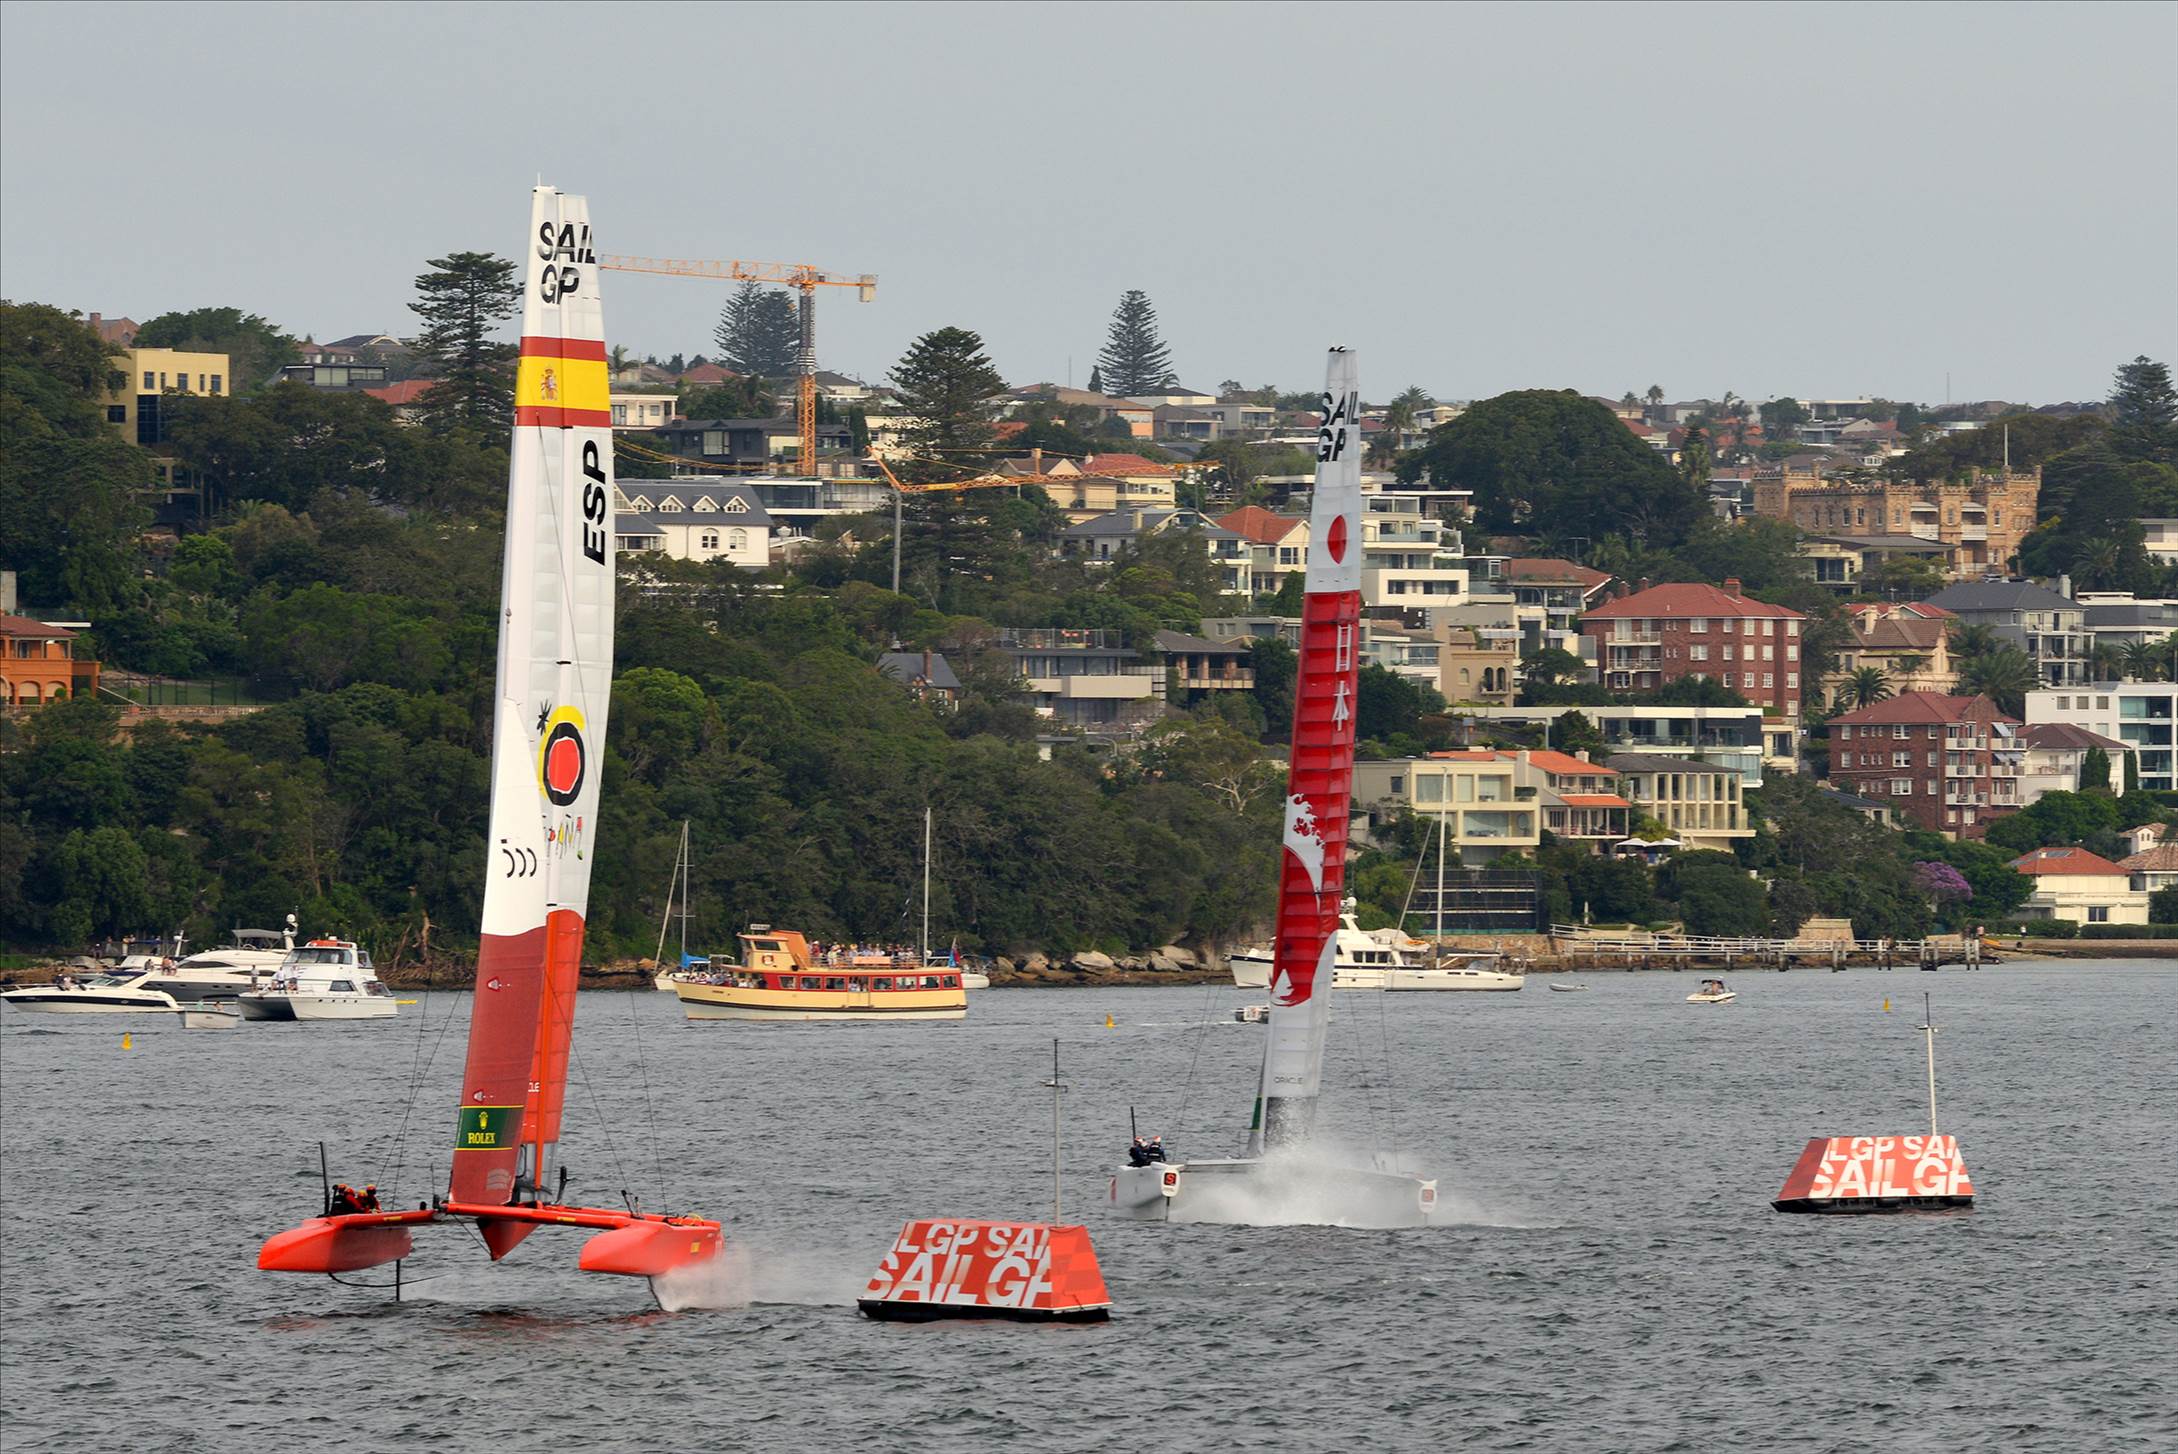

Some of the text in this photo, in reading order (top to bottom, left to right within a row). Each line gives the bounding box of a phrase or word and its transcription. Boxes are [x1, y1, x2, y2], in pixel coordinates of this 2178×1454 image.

[537, 222, 596, 264] SAIL
[540, 264, 580, 304] GP
[1319, 392, 1359, 426] SAIL
[1317, 428, 1346, 462] GP
[583, 440, 606, 566] ESP
[467, 1132, 496, 1144] ROLEX
[1851, 1137, 1895, 1160] GP
[1808, 1157, 1909, 1198] SAIL
[924, 1224, 979, 1255] GP
[861, 1249, 978, 1304] SAIL
